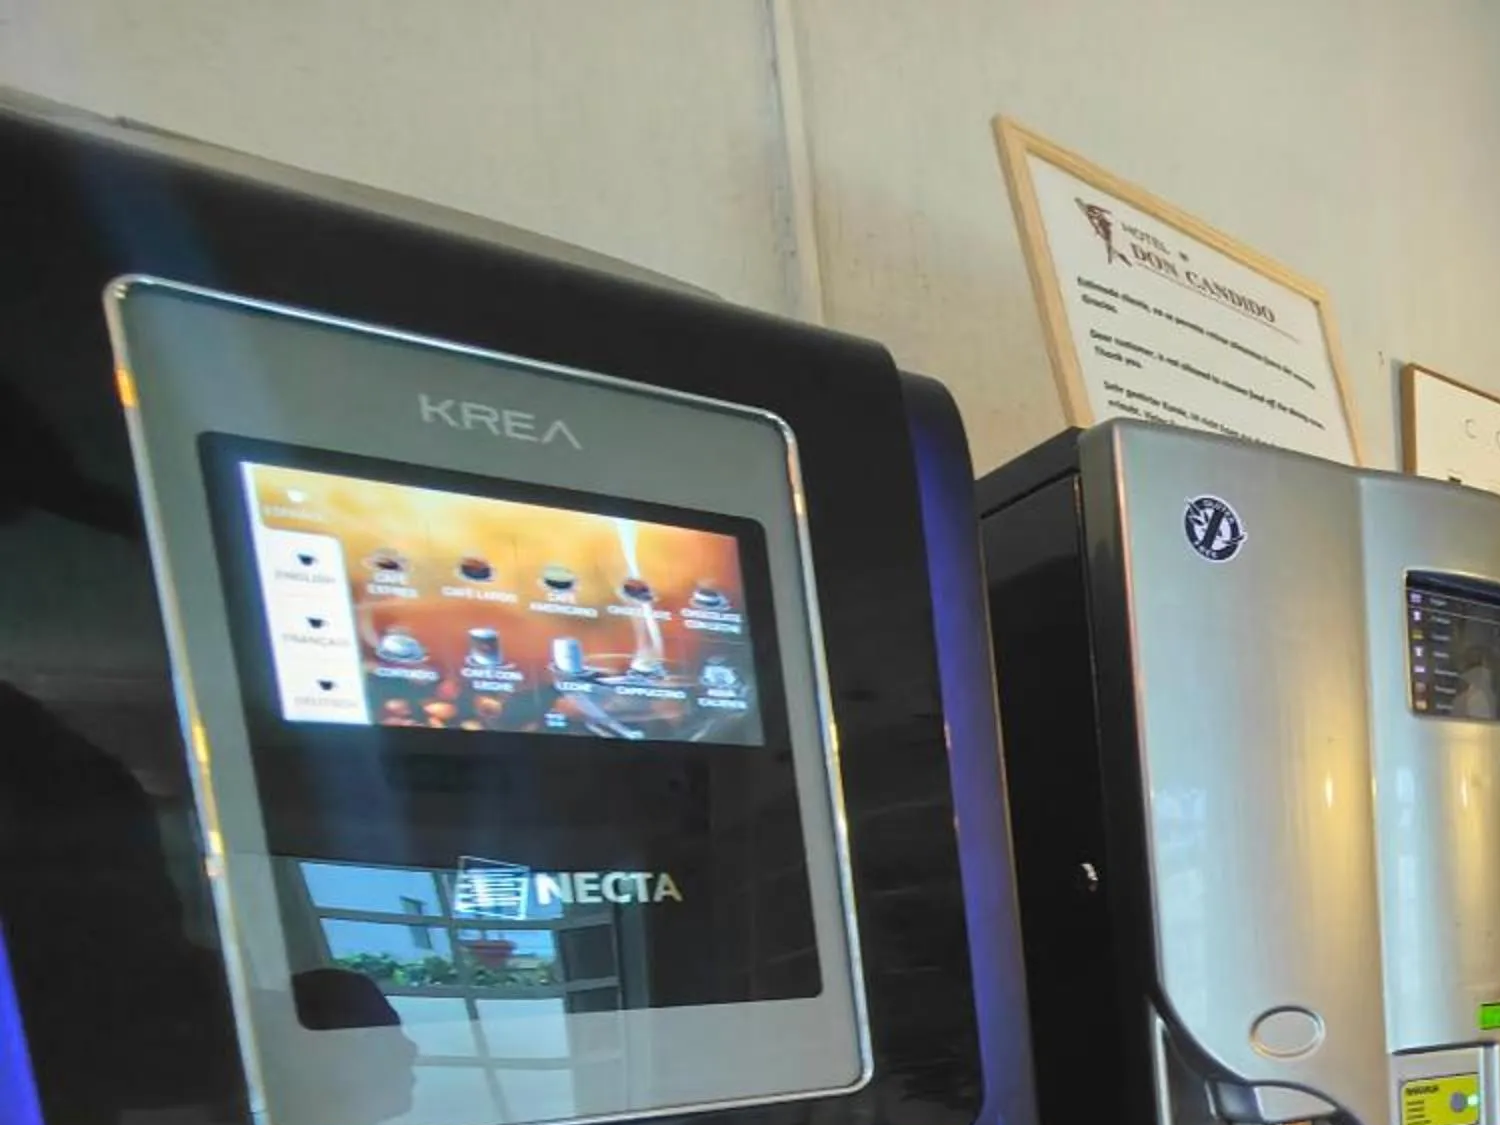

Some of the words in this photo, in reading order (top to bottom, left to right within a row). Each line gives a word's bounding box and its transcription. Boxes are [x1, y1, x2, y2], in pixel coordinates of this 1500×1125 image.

[1130, 242, 1179, 277] DON
[1185, 270, 1276, 323] CANDIDO
[419, 394, 582, 450] KREA
[534, 872, 683, 904] NECTA
